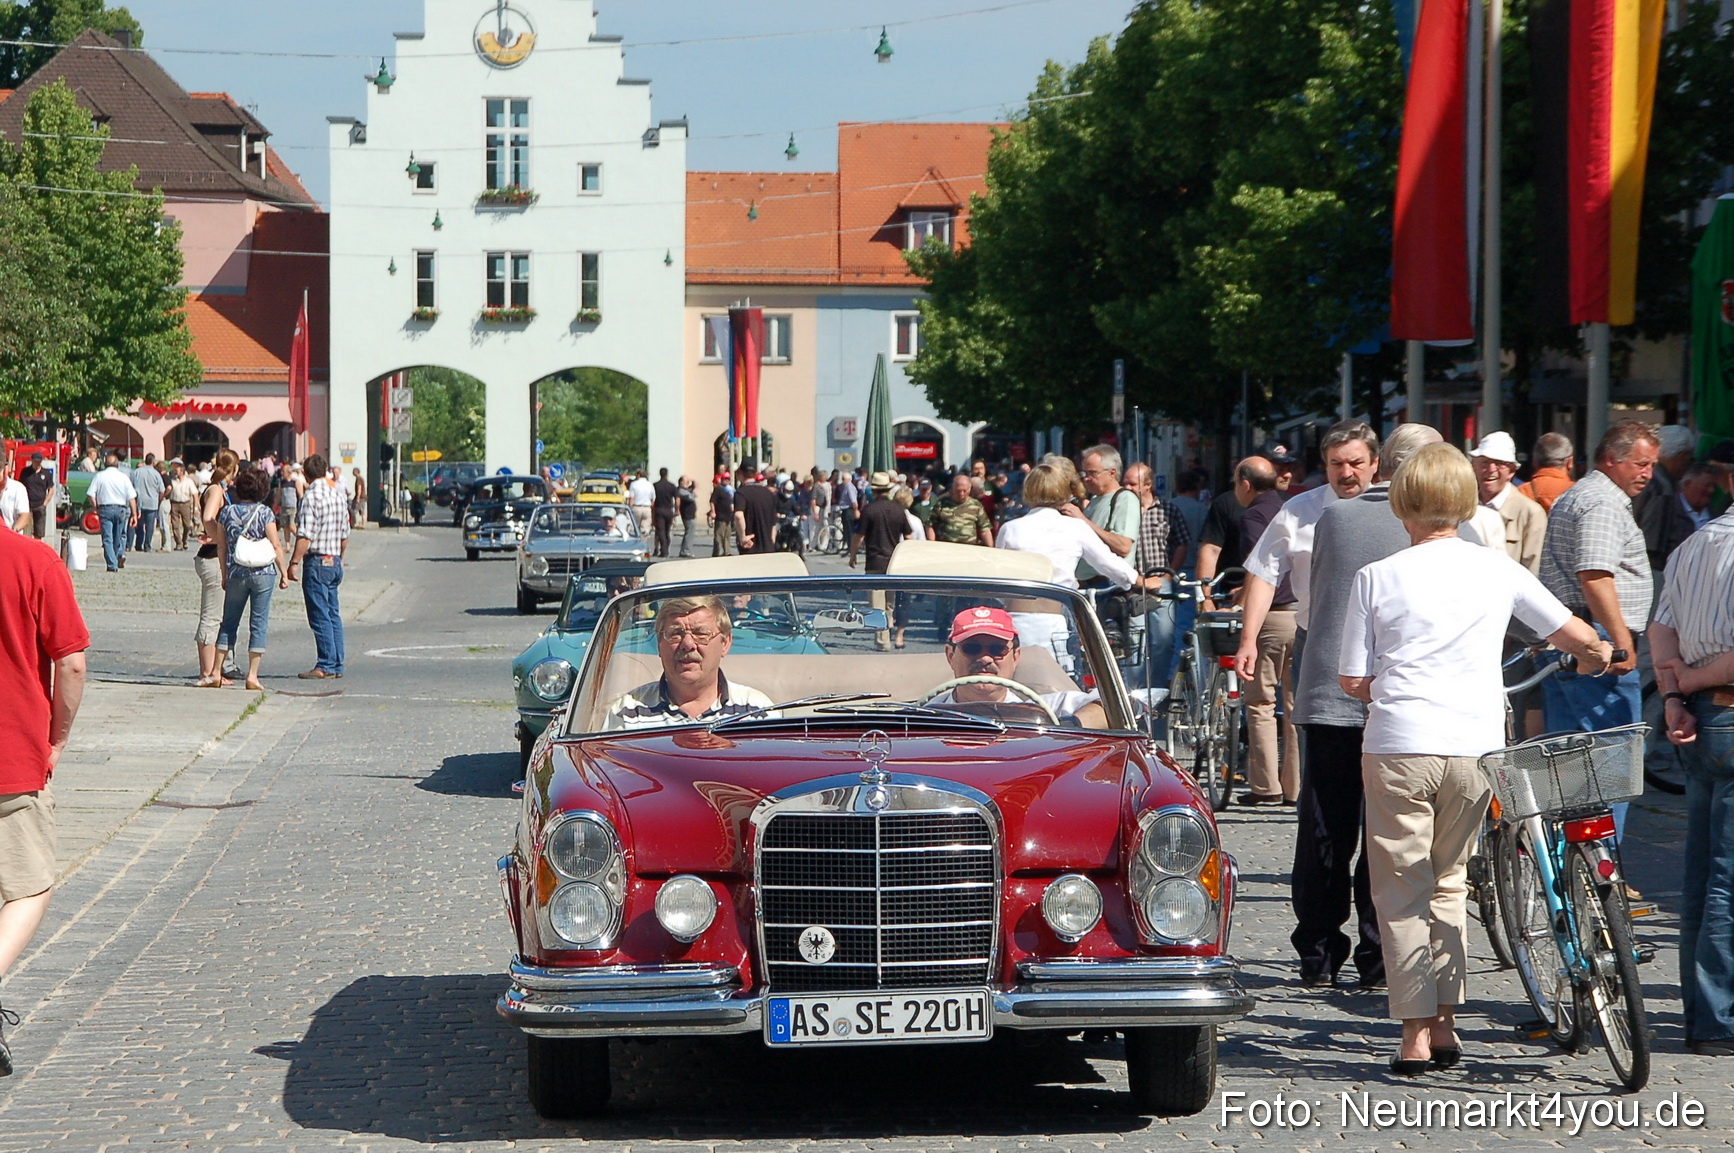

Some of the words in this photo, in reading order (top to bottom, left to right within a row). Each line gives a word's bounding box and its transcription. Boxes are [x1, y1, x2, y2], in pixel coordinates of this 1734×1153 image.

[143, 398, 247, 417] Sparkasse
[791, 1002, 830, 1037] AS
[856, 1000, 895, 1035] SE
[903, 998, 985, 1033] 220H
[776, 1024, 785, 1035] D
